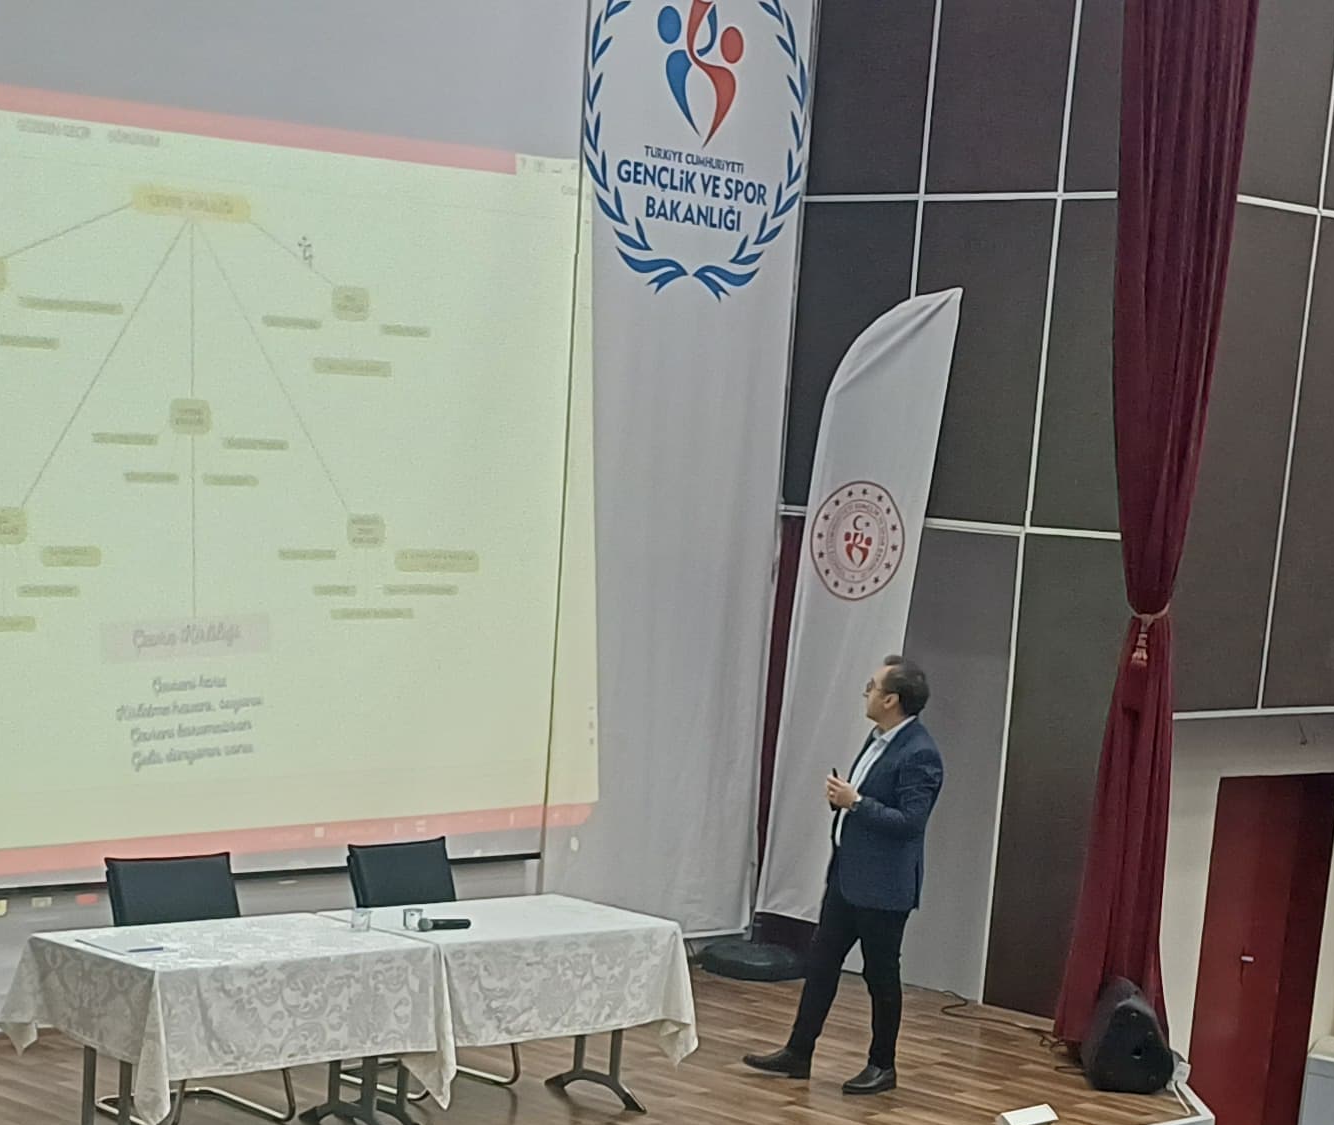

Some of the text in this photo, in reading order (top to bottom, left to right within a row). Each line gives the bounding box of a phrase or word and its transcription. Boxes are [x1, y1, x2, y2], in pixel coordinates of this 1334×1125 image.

[617, 159, 768, 207] GENÇLİK VE SPOR
[645, 195, 742, 233] BAKANLIĞI
